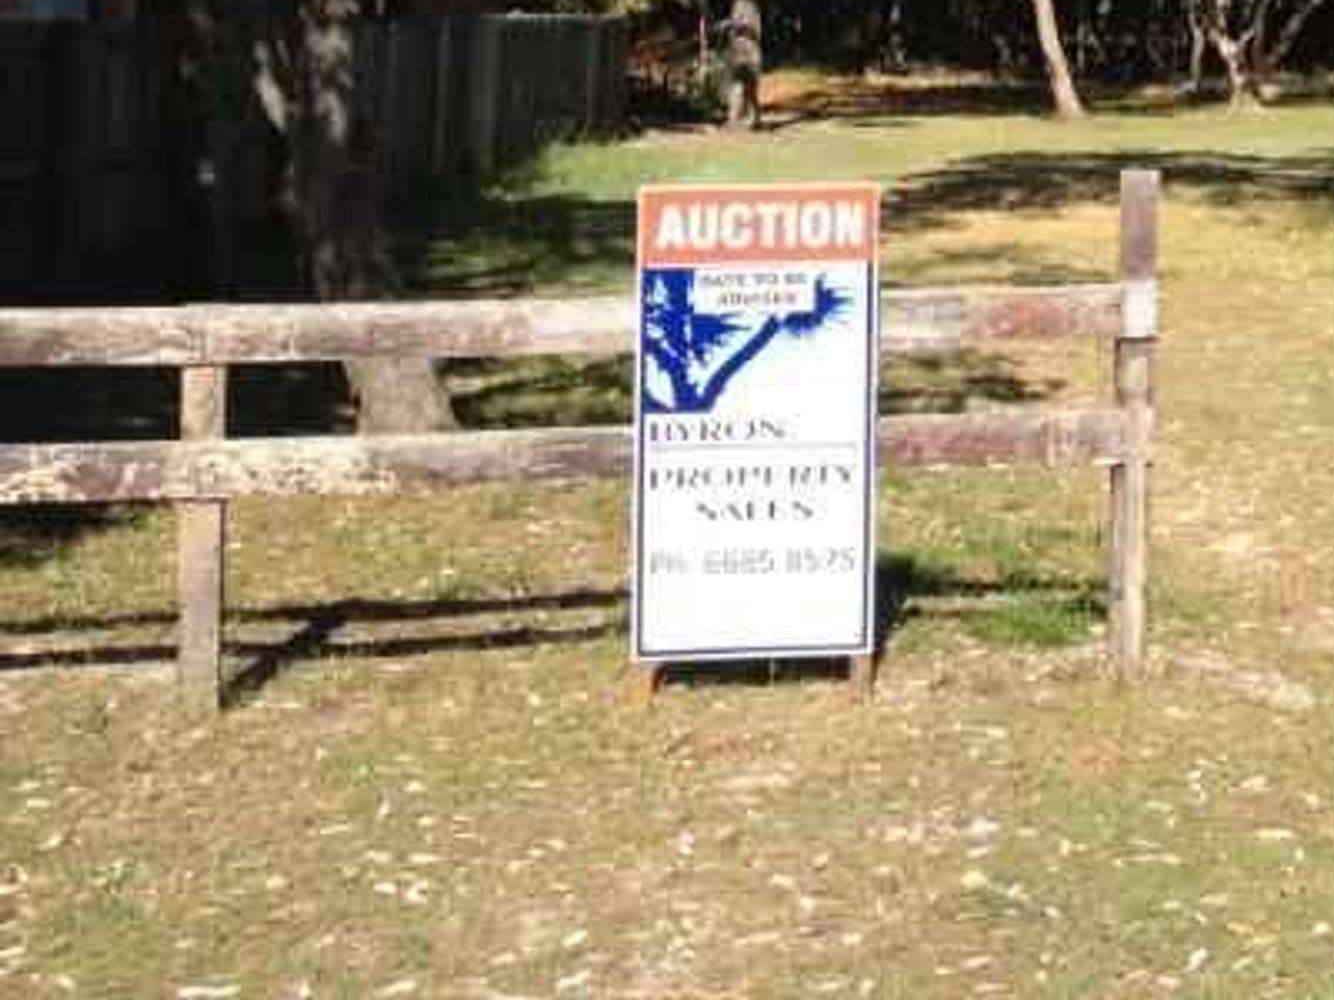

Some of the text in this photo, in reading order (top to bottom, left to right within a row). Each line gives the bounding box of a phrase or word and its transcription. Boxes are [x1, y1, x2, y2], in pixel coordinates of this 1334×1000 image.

[655, 200, 867, 251] AUCTION
[648, 418, 788, 443] BYRON
[648, 463, 855, 491] PROPERTY
[694, 499, 816, 523] SALES
